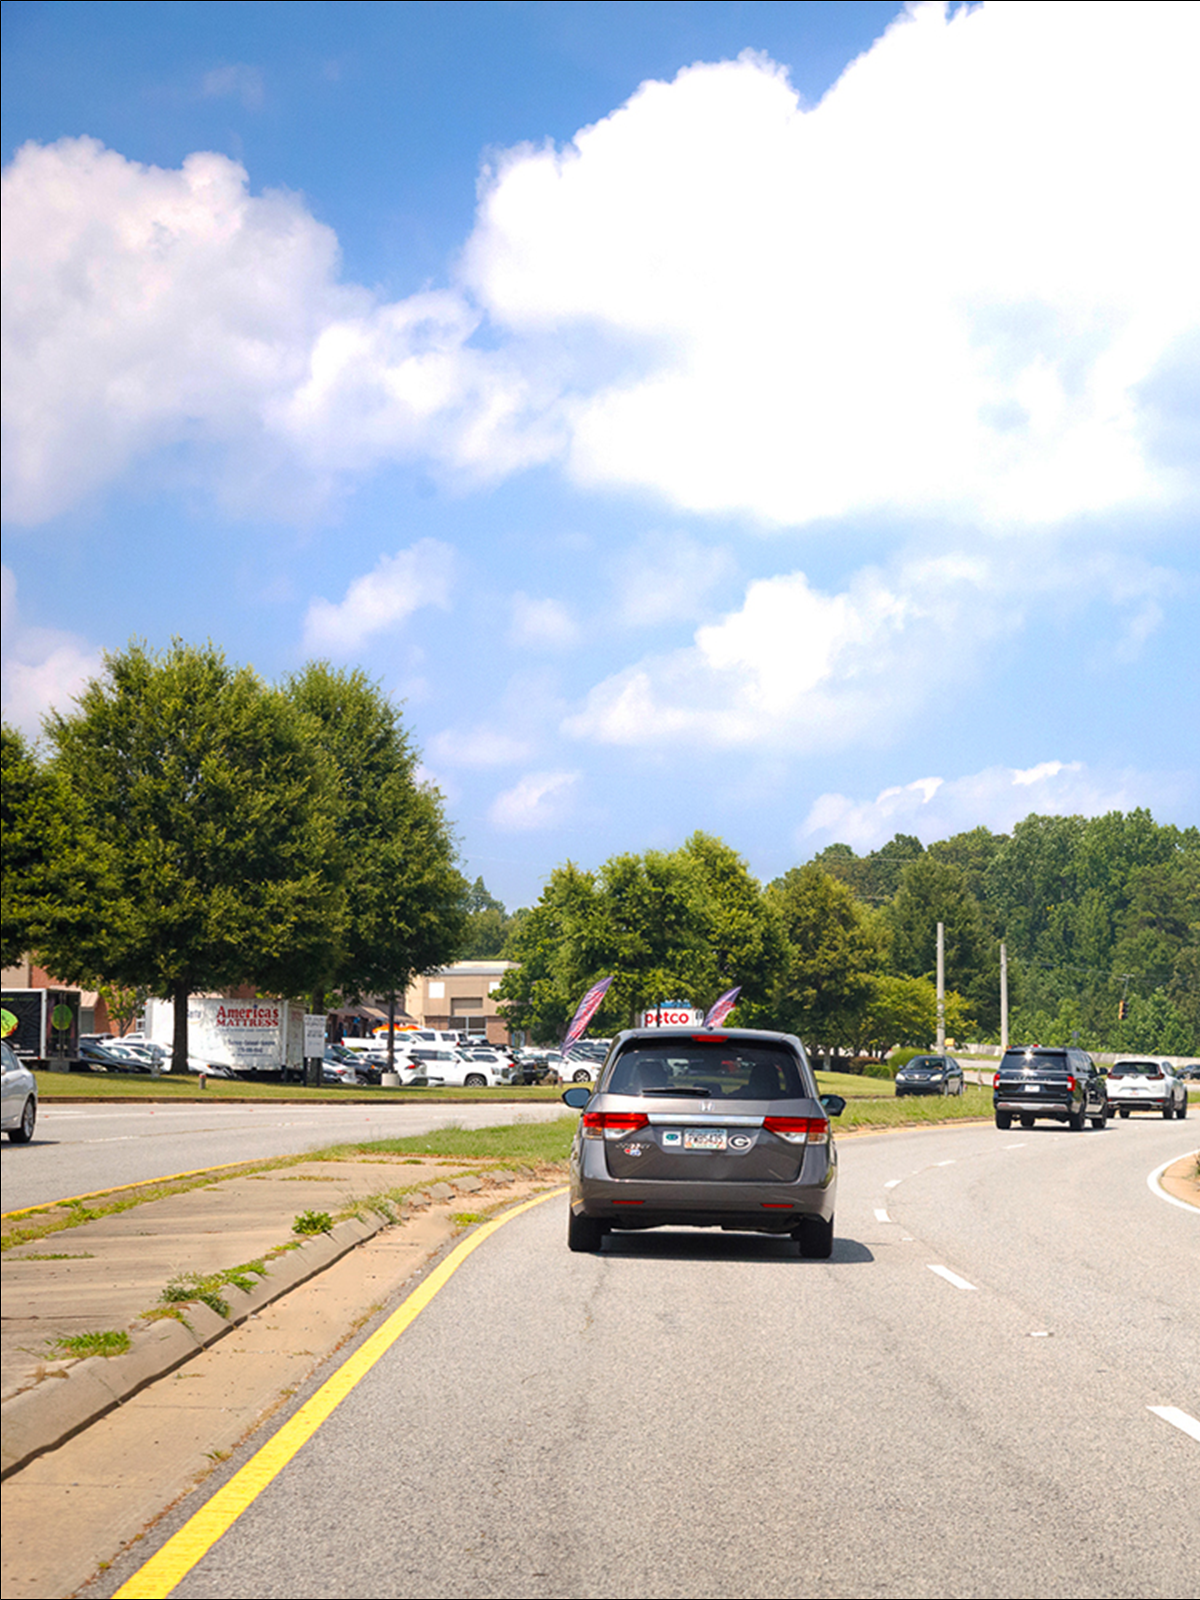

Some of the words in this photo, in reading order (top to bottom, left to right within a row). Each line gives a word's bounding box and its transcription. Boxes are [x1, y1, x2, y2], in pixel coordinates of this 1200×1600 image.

[216, 1004, 279, 1019] America's
[645, 1011, 690, 1027] petco
[216, 1019, 279, 1028] MATTRESS
